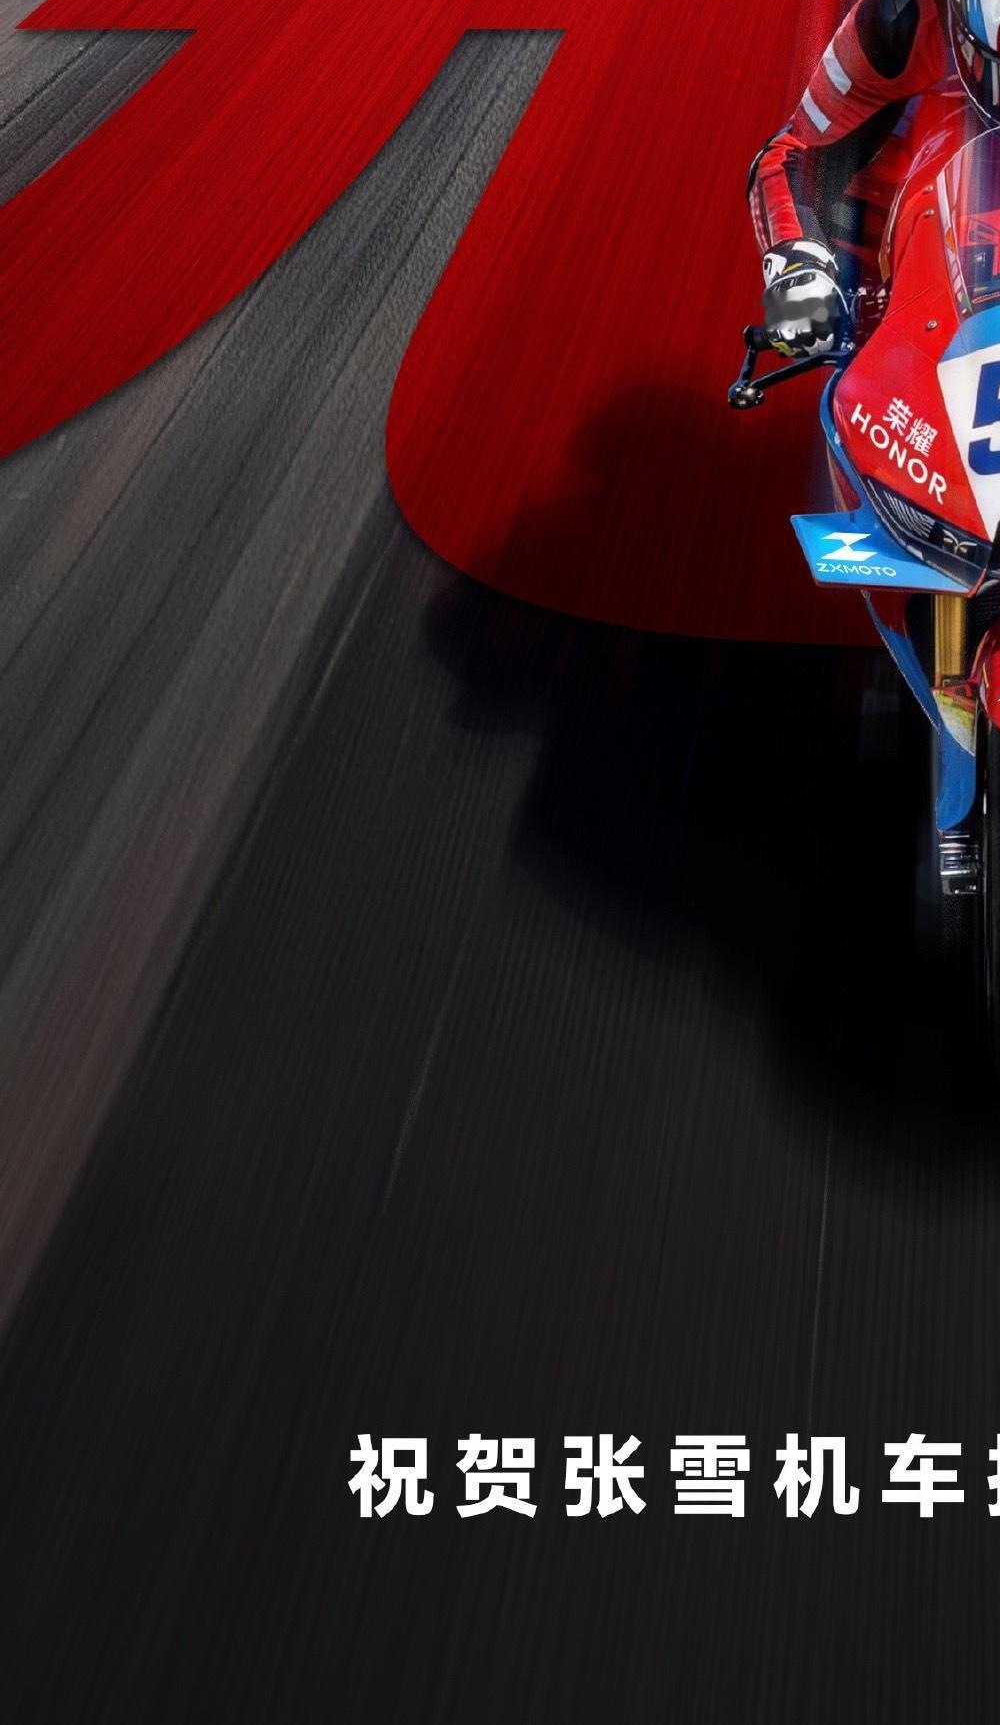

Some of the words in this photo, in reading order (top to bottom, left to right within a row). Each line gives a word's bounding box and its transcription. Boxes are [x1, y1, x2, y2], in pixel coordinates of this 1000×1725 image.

[850, 403, 948, 505] HONOR
[882, 397, 938, 457] 荣耀
[816, 562, 897, 577] ZXMOTO
